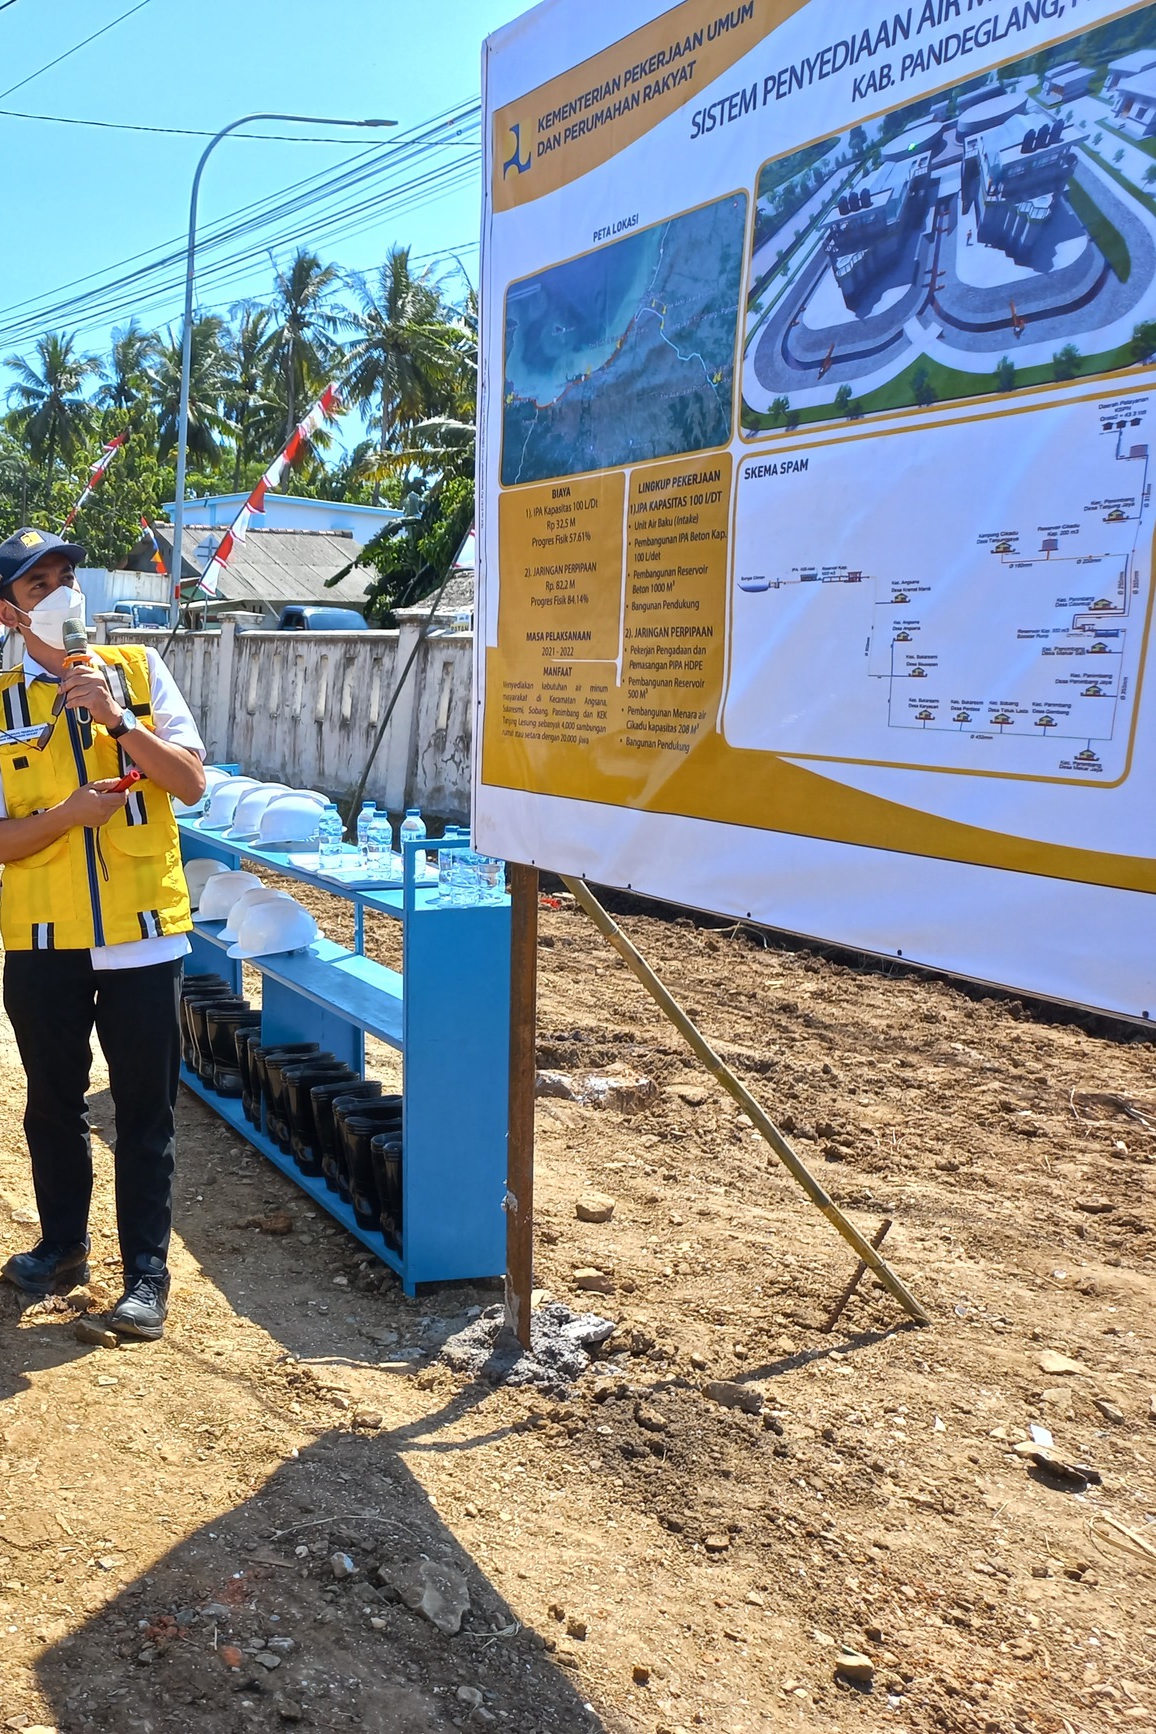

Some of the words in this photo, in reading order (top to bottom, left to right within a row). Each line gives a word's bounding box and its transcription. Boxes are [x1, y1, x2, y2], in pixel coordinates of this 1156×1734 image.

[851, 63, 895, 103] KAB.
[900, 0, 1065, 82] PANDEGLANG,
[537, 75, 620, 133] KEMENTERIAN
[623, 28, 703, 88] PEKERJAAN
[707, 0, 754, 41] UMUM
[690, 82, 757, 140] SISTEM
[762, 8, 913, 106] PENYEDIAAN
[916, 0, 961, 35] AIR
[537, 132, 561, 158] DAN
[564, 90, 640, 144] PERUMAHAN
[643, 60, 697, 104] RAKYAT
[592, 223, 612, 243] PETA
[612, 213, 640, 235] LOKASI
[744, 463, 778, 480] SKEMA
[779, 458, 810, 475] SPAM
[638, 478, 671, 494] LINGKUP
[671, 470, 721, 488] PEKERJAAN
[552, 487, 571, 499] BIAYA
[534, 507, 543, 517] IPA
[544, 503, 572, 517] Kapasitas
[573, 501, 584, 511] 100
[648, 496, 687, 512] KAPASITAS
[689, 493, 704, 506] 100
[547, 520, 555, 532] Rp
[569, 517, 576, 527] M
[634, 518, 647, 531] Unit
[647, 517, 657, 529] Air
[657, 516, 673, 528] Baku
[673, 513, 699, 527] (Intake)
[531, 537, 554, 548] Progres
[555, 534, 569, 545] Fisik
[634, 536, 677, 549] Pembangunan
[678, 531, 689, 543] IPA
[689, 530, 711, 542] Beton
[711, 529, 728, 544] Kap.
[634, 553, 645, 562] 100
[645, 551, 661, 562] L/det
[532, 565, 563, 577] JARINGAN
[563, 562, 597, 574] PERPIPAAN
[633, 568, 676, 581] Pembangunan
[677, 565, 709, 576] Reservoir
[569, 579, 576, 589] M
[632, 583, 650, 594] Beton
[650, 582, 666, 593] 1000
[530, 597, 553, 608] Progres
[553, 595, 567, 605] Fisik
[631, 600, 662, 613] Bangunan
[663, 599, 700, 612] Pendukung
[526, 632, 545, 641] MASA
[545, 631, 592, 641] PELAKSANAAN
[634, 627, 669, 638] JARINGAN
[670, 626, 714, 637] PERPIPAAN
[541, 647, 555, 656] 2021
[560, 646, 574, 656] 2022
[630, 645, 655, 656] Pekerjan
[656, 645, 692, 657] Pengadaan
[693, 645, 706, 655] dan
[543, 667, 572, 677] MANFAAT
[629, 660, 668, 672] Pemasangan
[668, 660, 683, 670] PIPA
[684, 660, 703, 670] HDPE
[628, 677, 673, 689] Pembangunan
[673, 678, 705, 688] Reservoir
[627, 689, 639, 699] 500
[583, 709, 593, 718] dan
[627, 706, 672, 719] Pembangunan
[672, 708, 697, 719] Menara
[698, 710, 707, 720] air
[576, 724, 607, 734] sambungan
[626, 720, 647, 731] Cikadu
[648, 722, 677, 734] kapasitas
[625, 737, 656, 749] Bangunan
[657, 739, 690, 754] Pendukung
